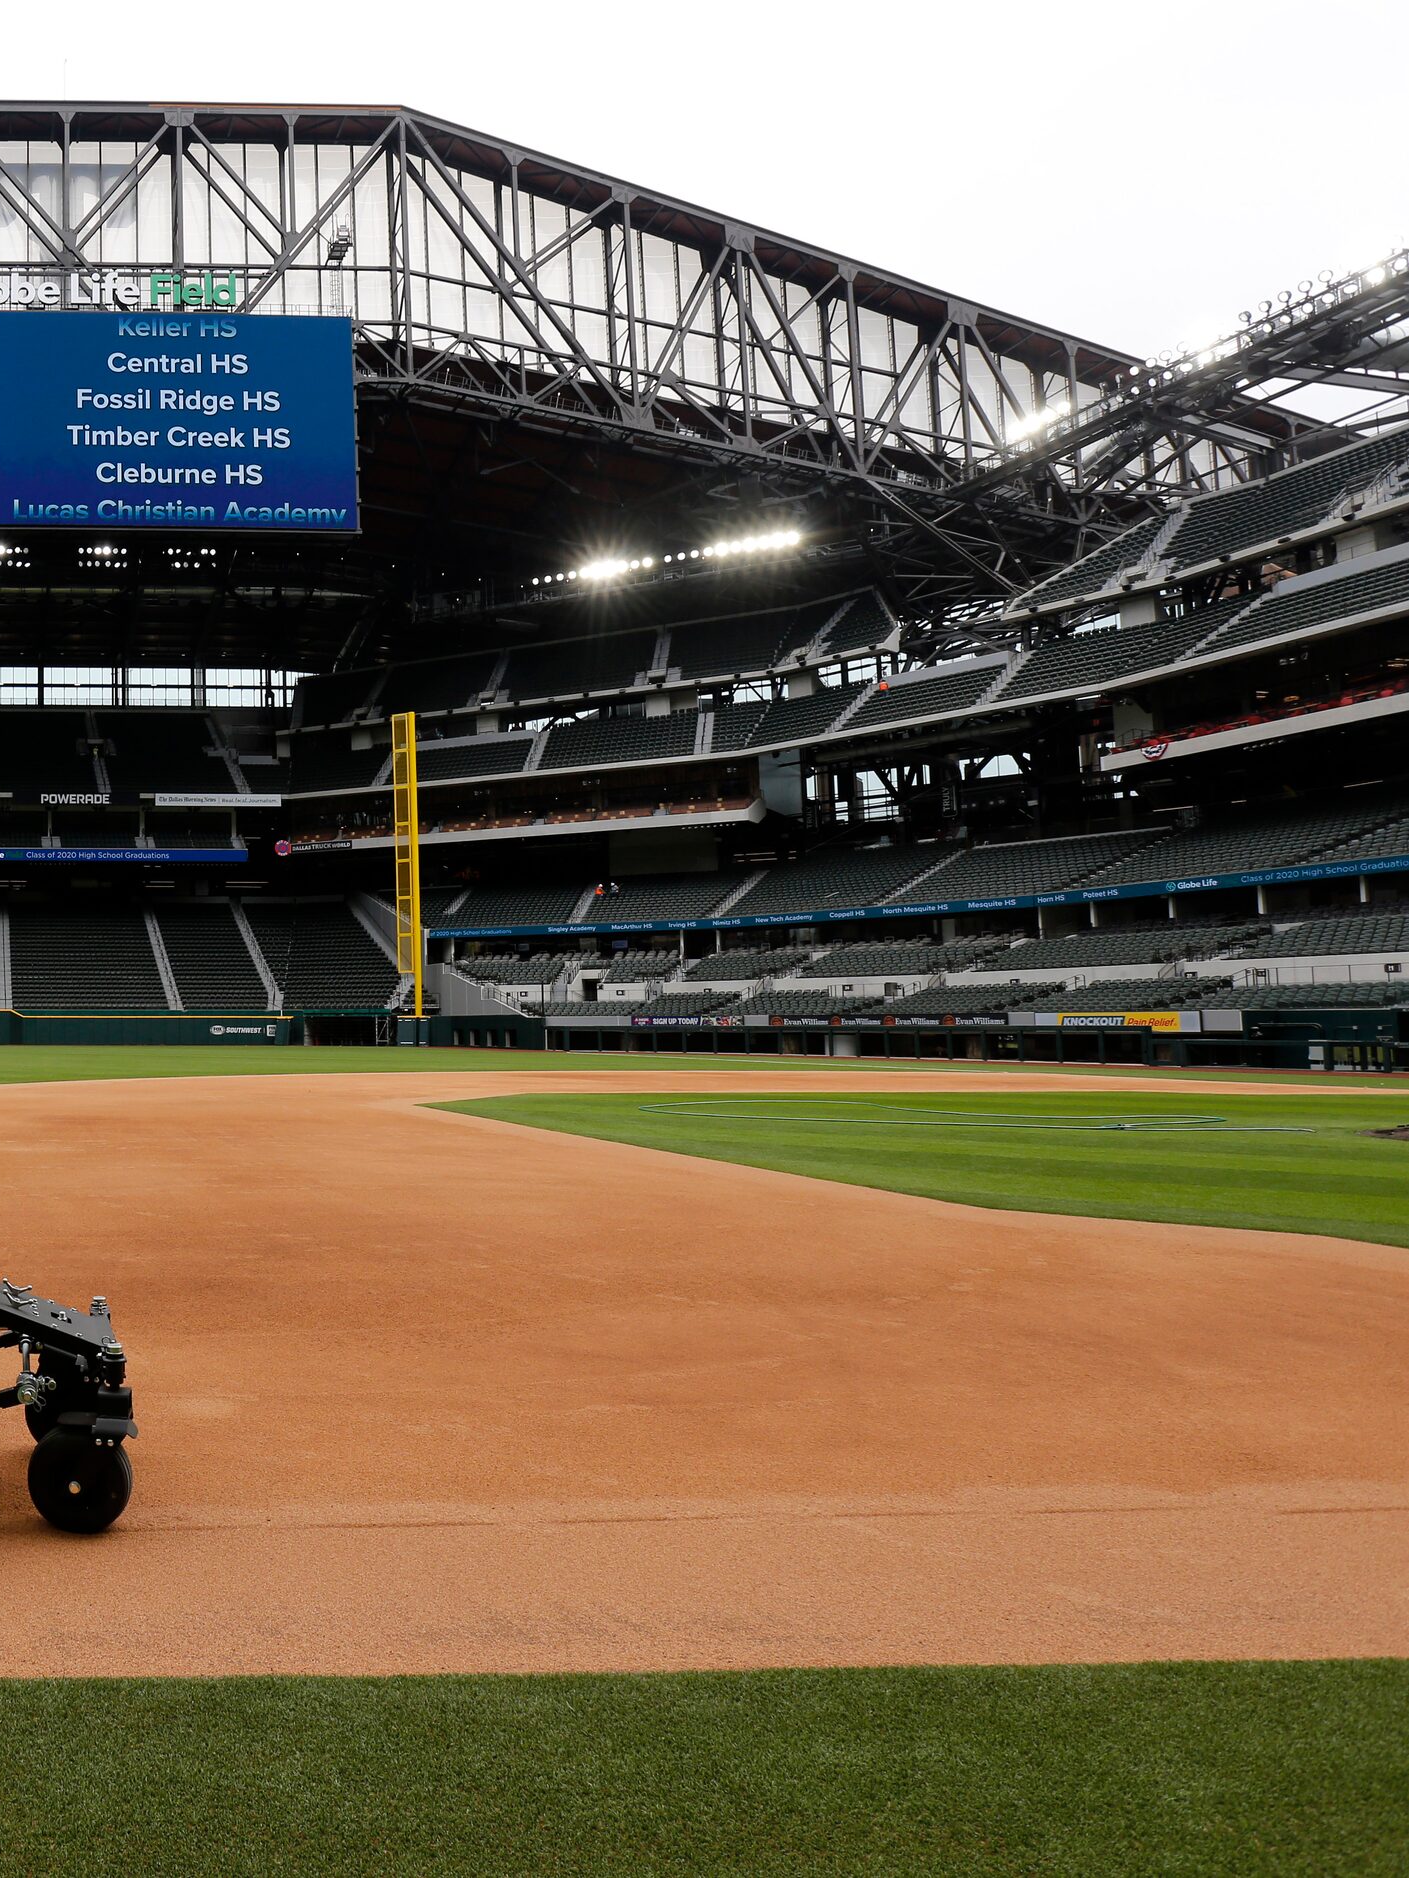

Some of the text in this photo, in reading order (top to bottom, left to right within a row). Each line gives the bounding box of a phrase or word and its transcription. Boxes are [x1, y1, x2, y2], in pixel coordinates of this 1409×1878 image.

[70, 272, 141, 305] Life
[151, 273, 236, 305] Field
[118, 317, 237, 338] Keller HS
[107, 352, 249, 374] Central HS
[76, 388, 281, 416] Fossil Ridge HS
[67, 424, 291, 449] Timber Creek HS
[96, 462, 263, 485] Cleburne HS
[13, 499, 347, 524] Lucas Christian Academy
[40, 793, 111, 805] POWERADE
[26, 851, 46, 859] Class
[48, 851, 56, 859] of
[57, 851, 77, 859] 2020
[79, 851, 96, 860] High
[98, 851, 123, 860] School
[125, 851, 170, 860] Graduations
[1240, 875, 1263, 883] Class
[1265, 872, 1274, 880] of
[1276, 870, 1299, 880] 2020
[1301, 868, 1323, 877] High
[1325, 864, 1358, 875] School
[1177, 878, 1218, 890] Globe Life
[1054, 894, 1065, 902] HS
[1082, 888, 1119, 899] Poteet HS
[882, 903, 949, 915] North Mesquite HS
[967, 898, 1017, 910] Mesquite HS
[784, 914, 813, 922] Academy
[829, 910, 854, 919] Coppell
[652, 1017, 668, 1025] SIGN
[668, 1017, 677, 1025] UP
[678, 1017, 699, 1025] TODAY
[1063, 1016, 1124, 1026] KNOCKOUT
[1127, 1017, 1146, 1026] Pain
